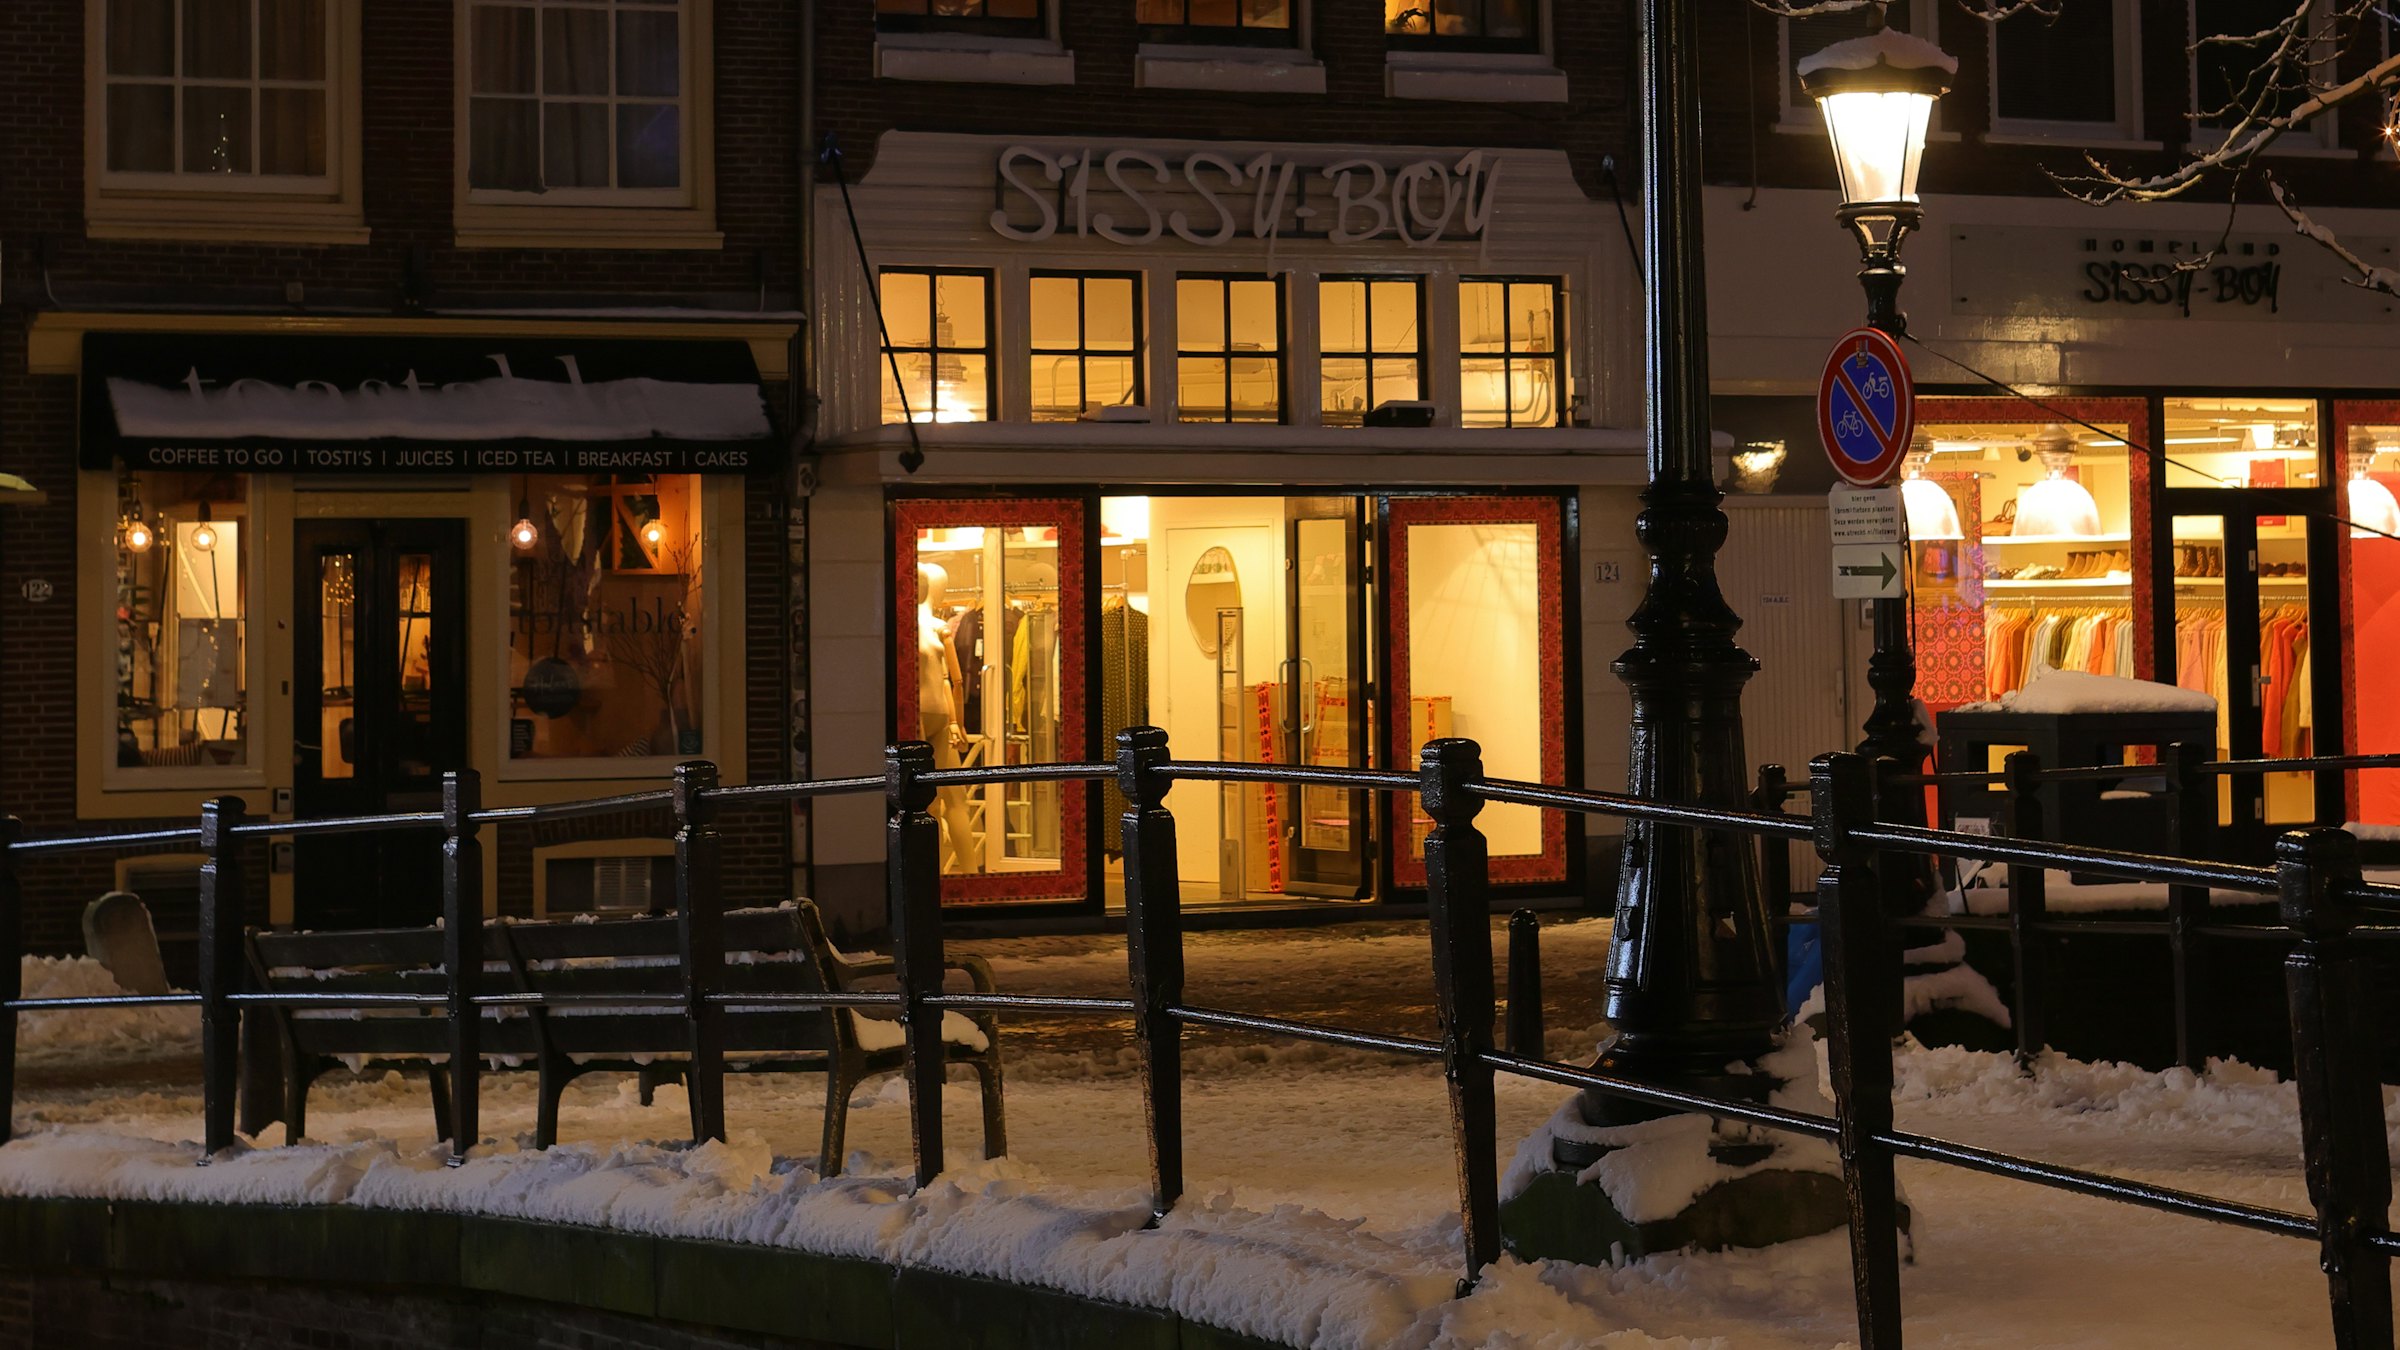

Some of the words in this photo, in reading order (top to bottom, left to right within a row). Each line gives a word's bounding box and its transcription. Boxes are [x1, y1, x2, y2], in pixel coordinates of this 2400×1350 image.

[990, 146, 1499, 279] SISSY-BOY
[149, 448, 219, 464] COFFEE
[225, 449, 249, 465] TO
[254, 449, 284, 465] GO
[307, 450, 372, 466] TOSTI'S
[396, 450, 454, 466] JUICES
[477, 451, 517, 466] ICED
[523, 451, 555, 466] TEA
[578, 451, 672, 467] BREAKFAST
[695, 451, 748, 467] CAKES
